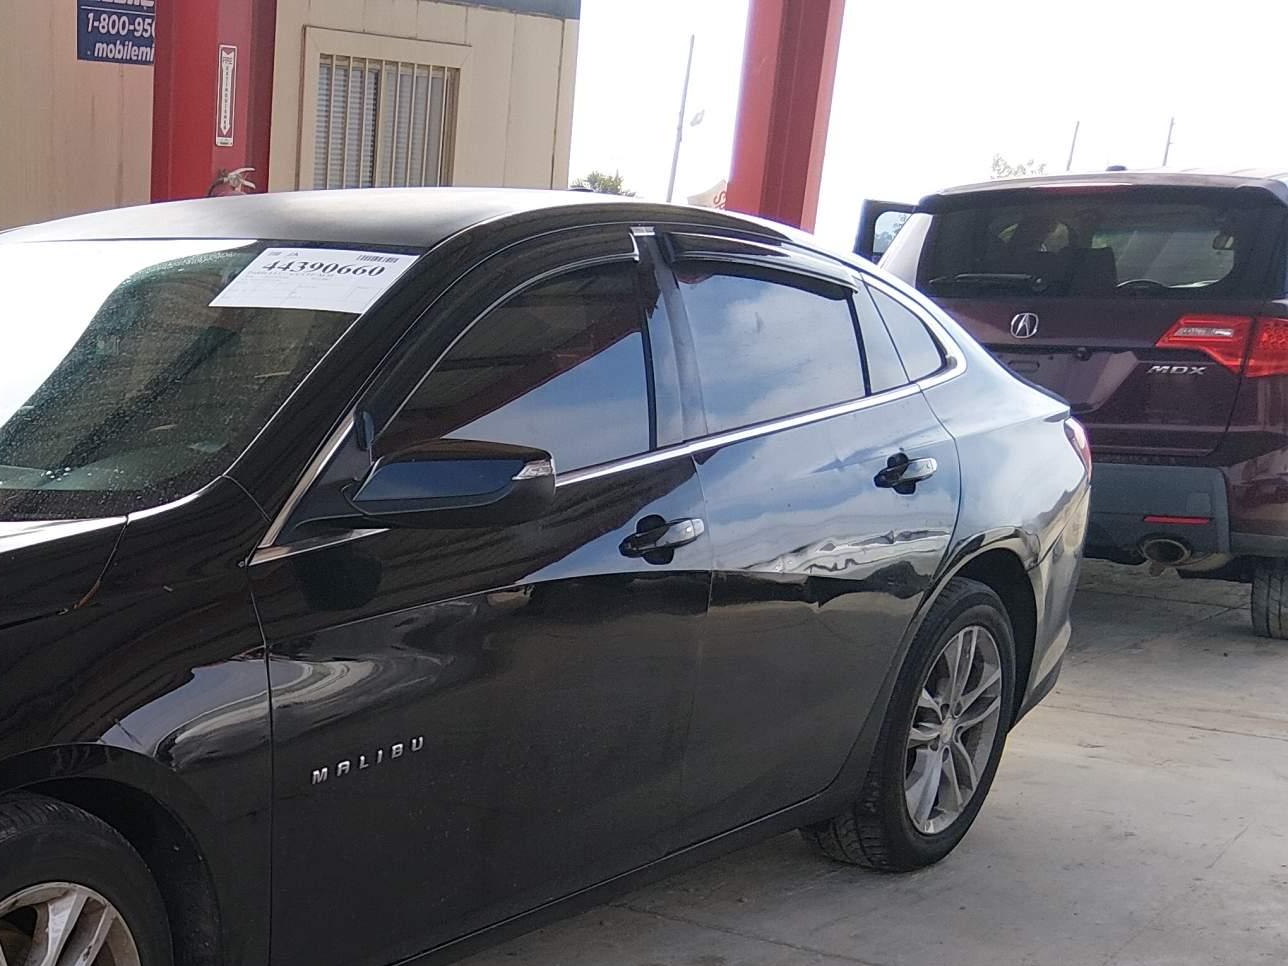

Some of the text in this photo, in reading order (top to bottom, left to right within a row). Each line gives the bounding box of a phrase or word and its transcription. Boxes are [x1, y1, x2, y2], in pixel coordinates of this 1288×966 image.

[262, 259, 386, 277] 44390660
[1146, 365, 1207, 375] MDX
[312, 736, 424, 785] MALIBU
